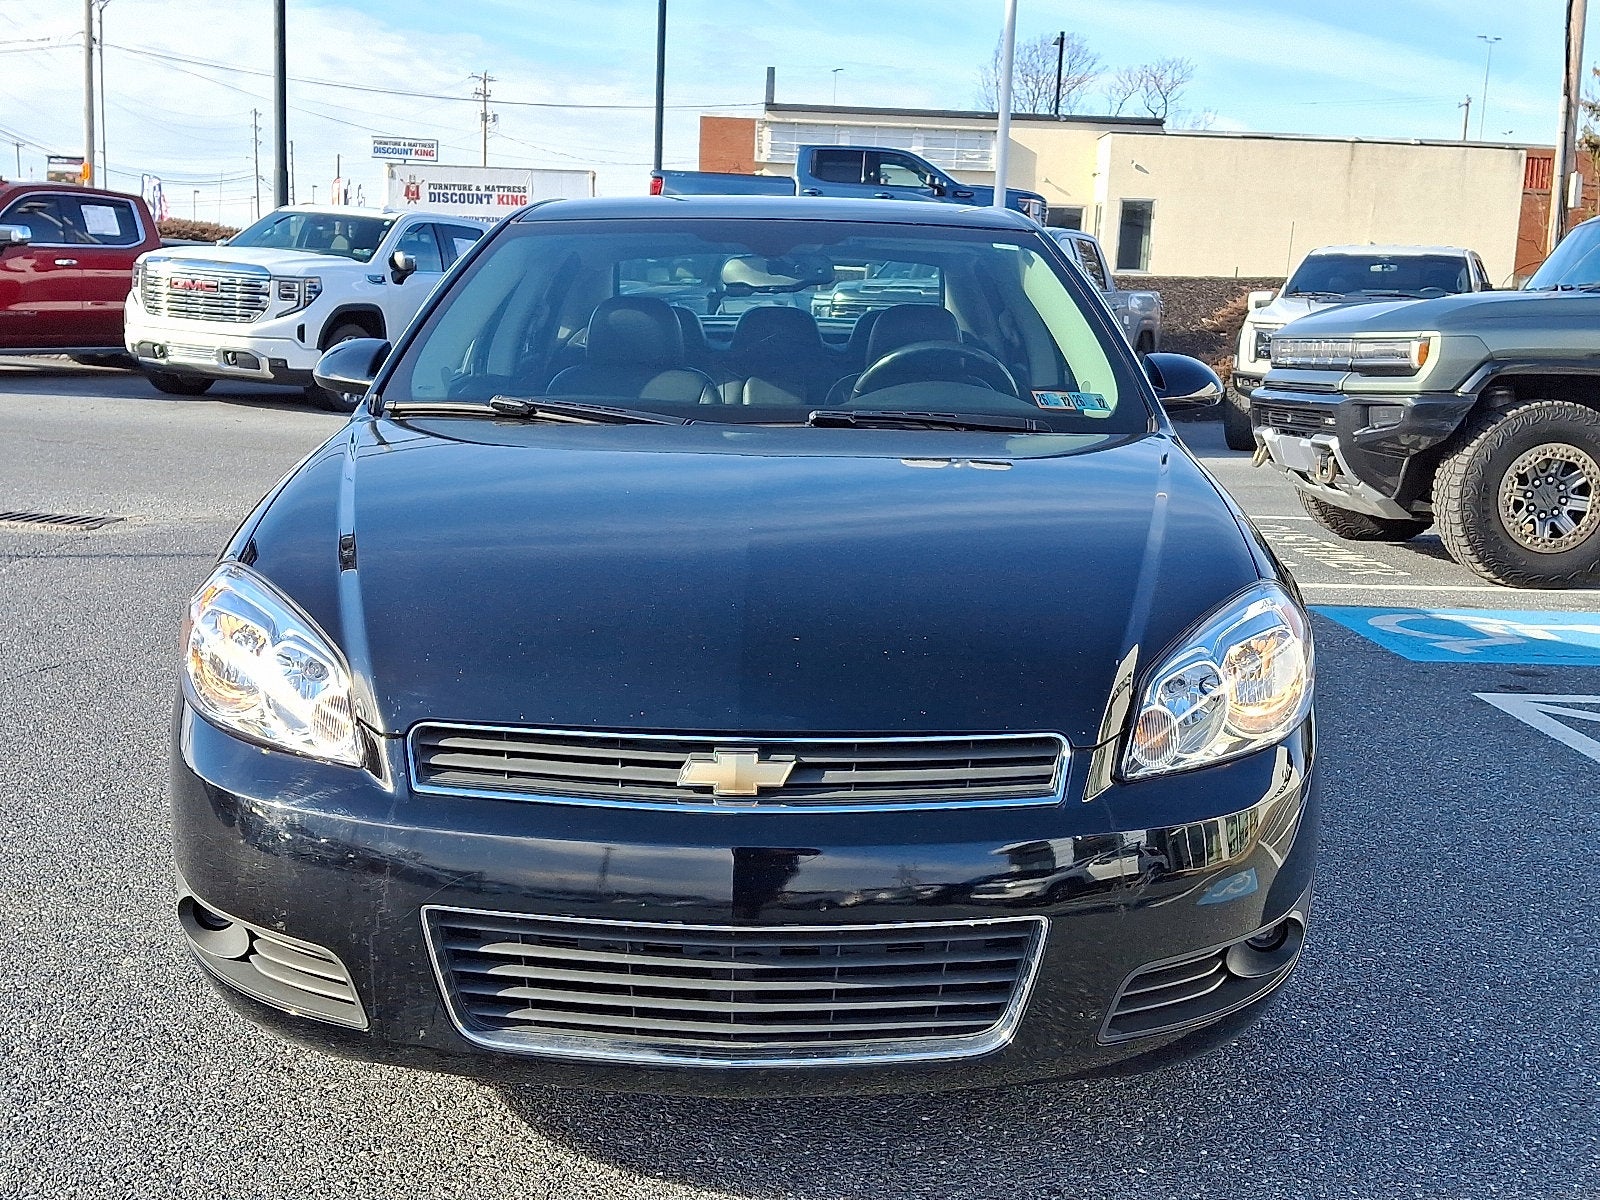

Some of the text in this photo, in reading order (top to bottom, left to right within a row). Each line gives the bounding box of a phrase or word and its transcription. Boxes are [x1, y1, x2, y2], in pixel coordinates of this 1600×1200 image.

[373, 146, 435, 157] DISCOUNT KING
[428, 182, 473, 191] FURNITURE
[484, 185, 527, 193] MATTRESS
[428, 192, 528, 206] DISCOUNT KING
[170, 278, 218, 292] GMC
[1035, 393, 1073, 407] 26 12
[1072, 394, 1086, 407] 26
